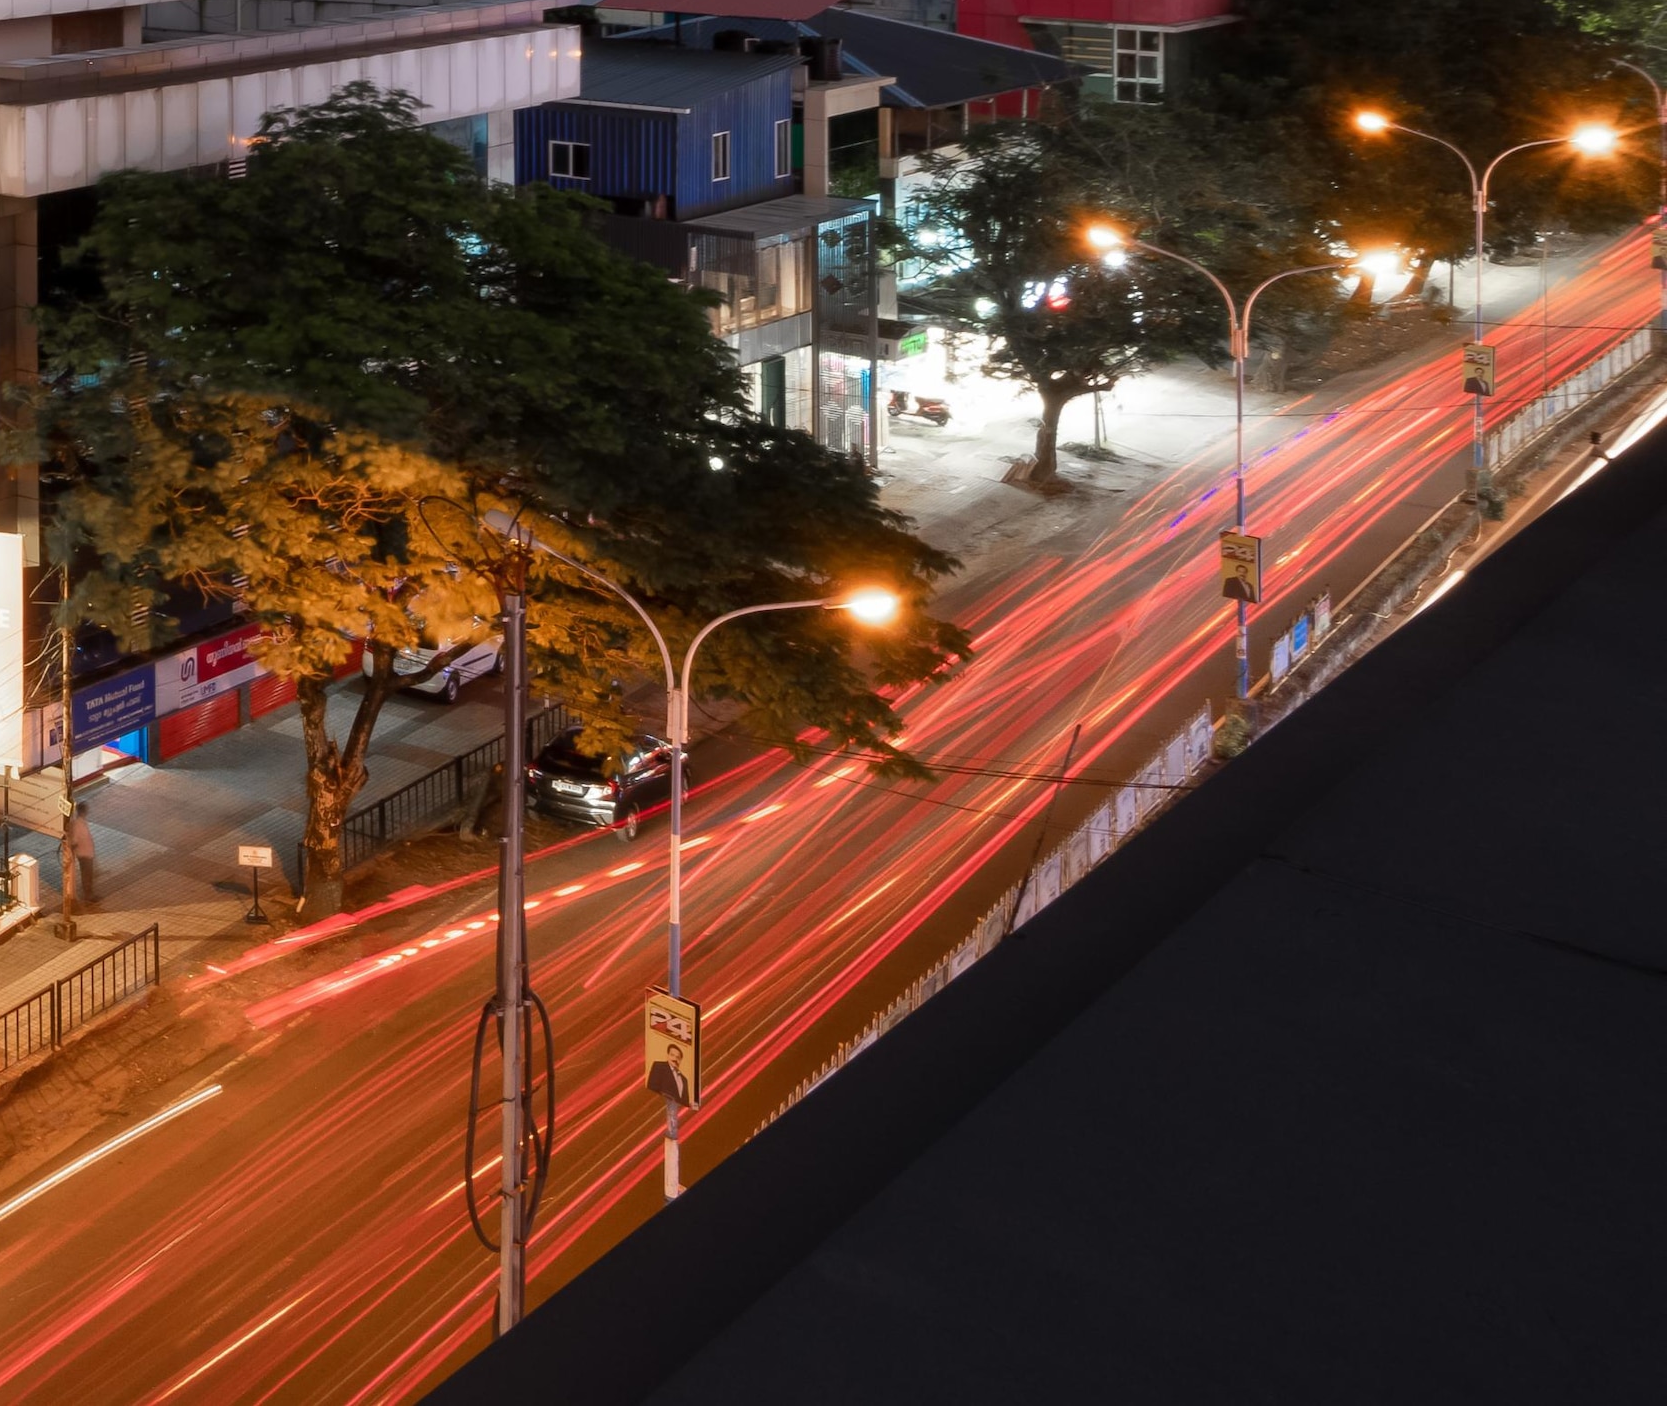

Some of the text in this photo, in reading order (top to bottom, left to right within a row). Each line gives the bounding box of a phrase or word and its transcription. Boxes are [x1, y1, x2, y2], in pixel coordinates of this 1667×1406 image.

[86, 696, 104, 710] TATA
[104, 686, 128, 703] Mutual
[128, 680, 145, 693] Fund
